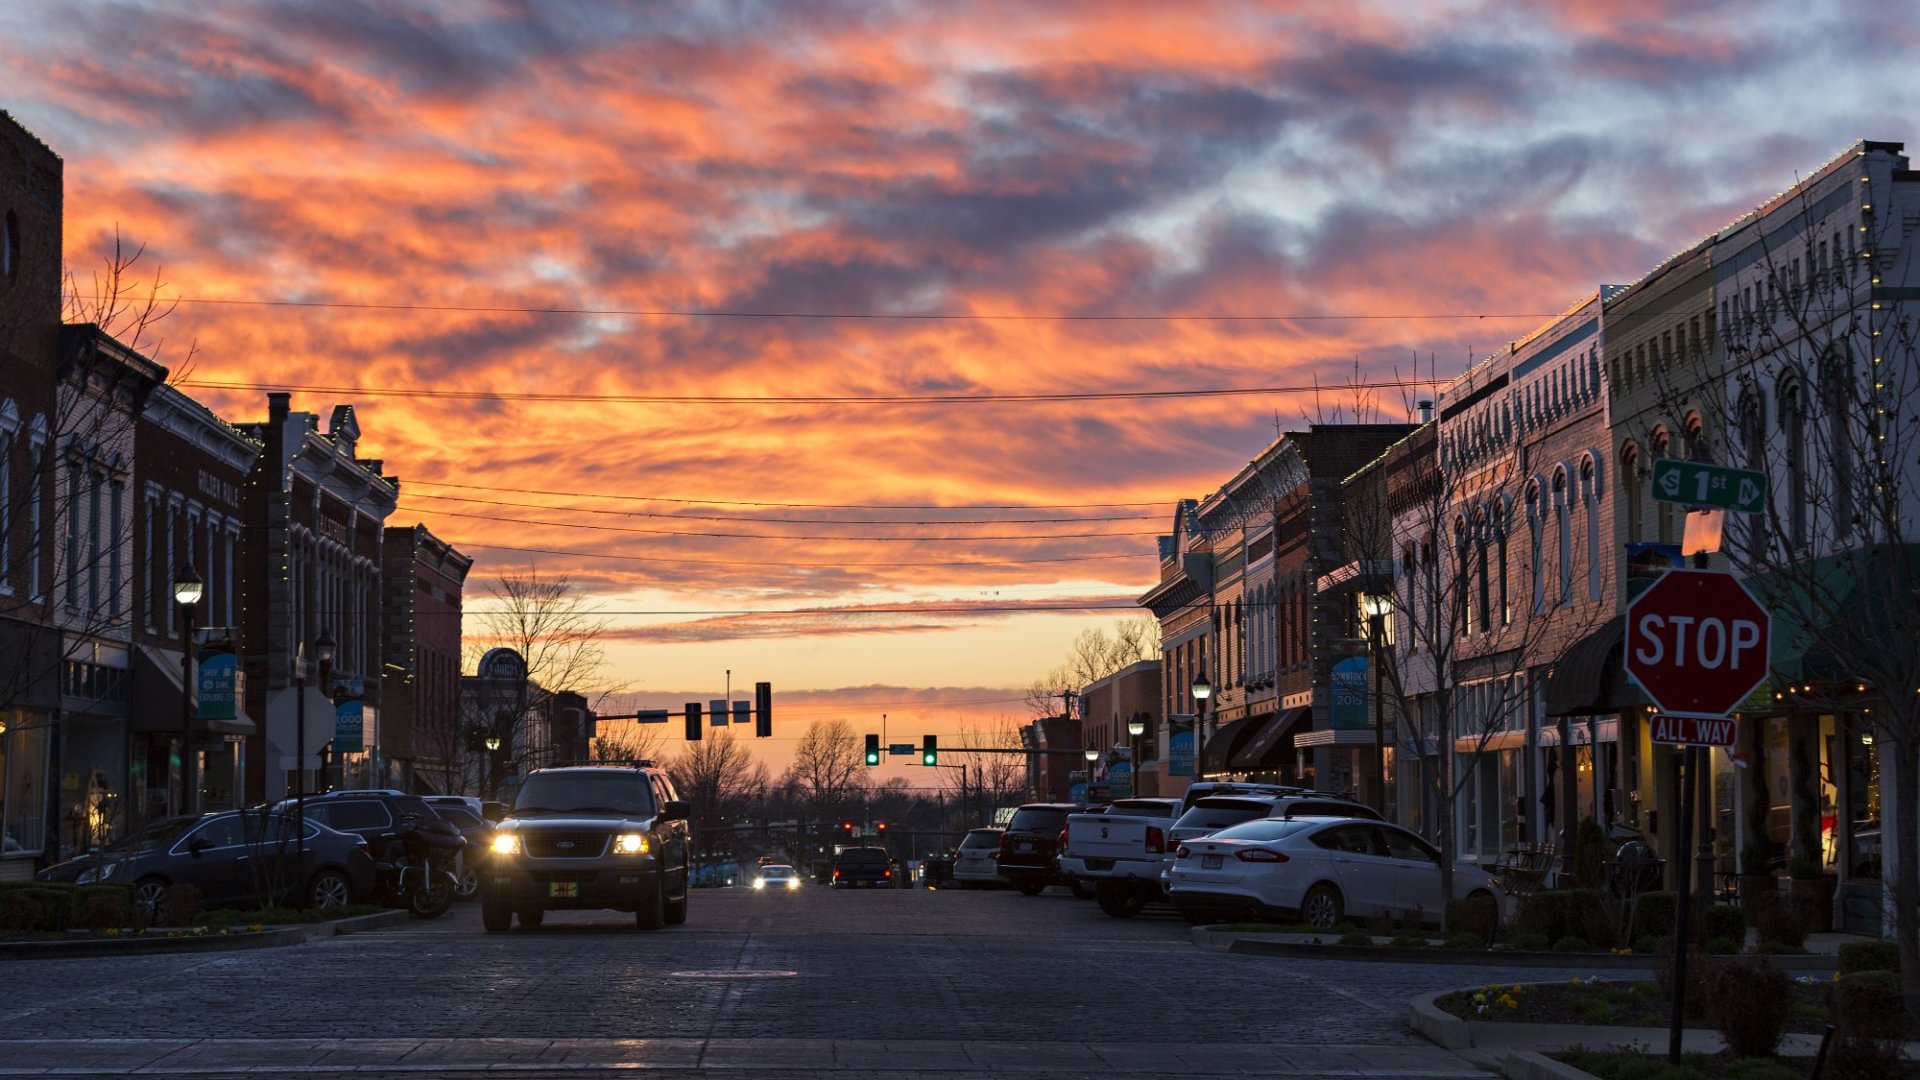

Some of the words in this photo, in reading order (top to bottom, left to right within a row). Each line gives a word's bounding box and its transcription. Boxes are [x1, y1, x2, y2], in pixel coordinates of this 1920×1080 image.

[1665, 475, 1677, 489] S
[1694, 470, 1728, 501] 1st
[1741, 484, 1753, 500] N
[1635, 613, 1760, 670] STOP
[1656, 718, 1687, 741] ALL
[1696, 721, 1731, 745] WAY
